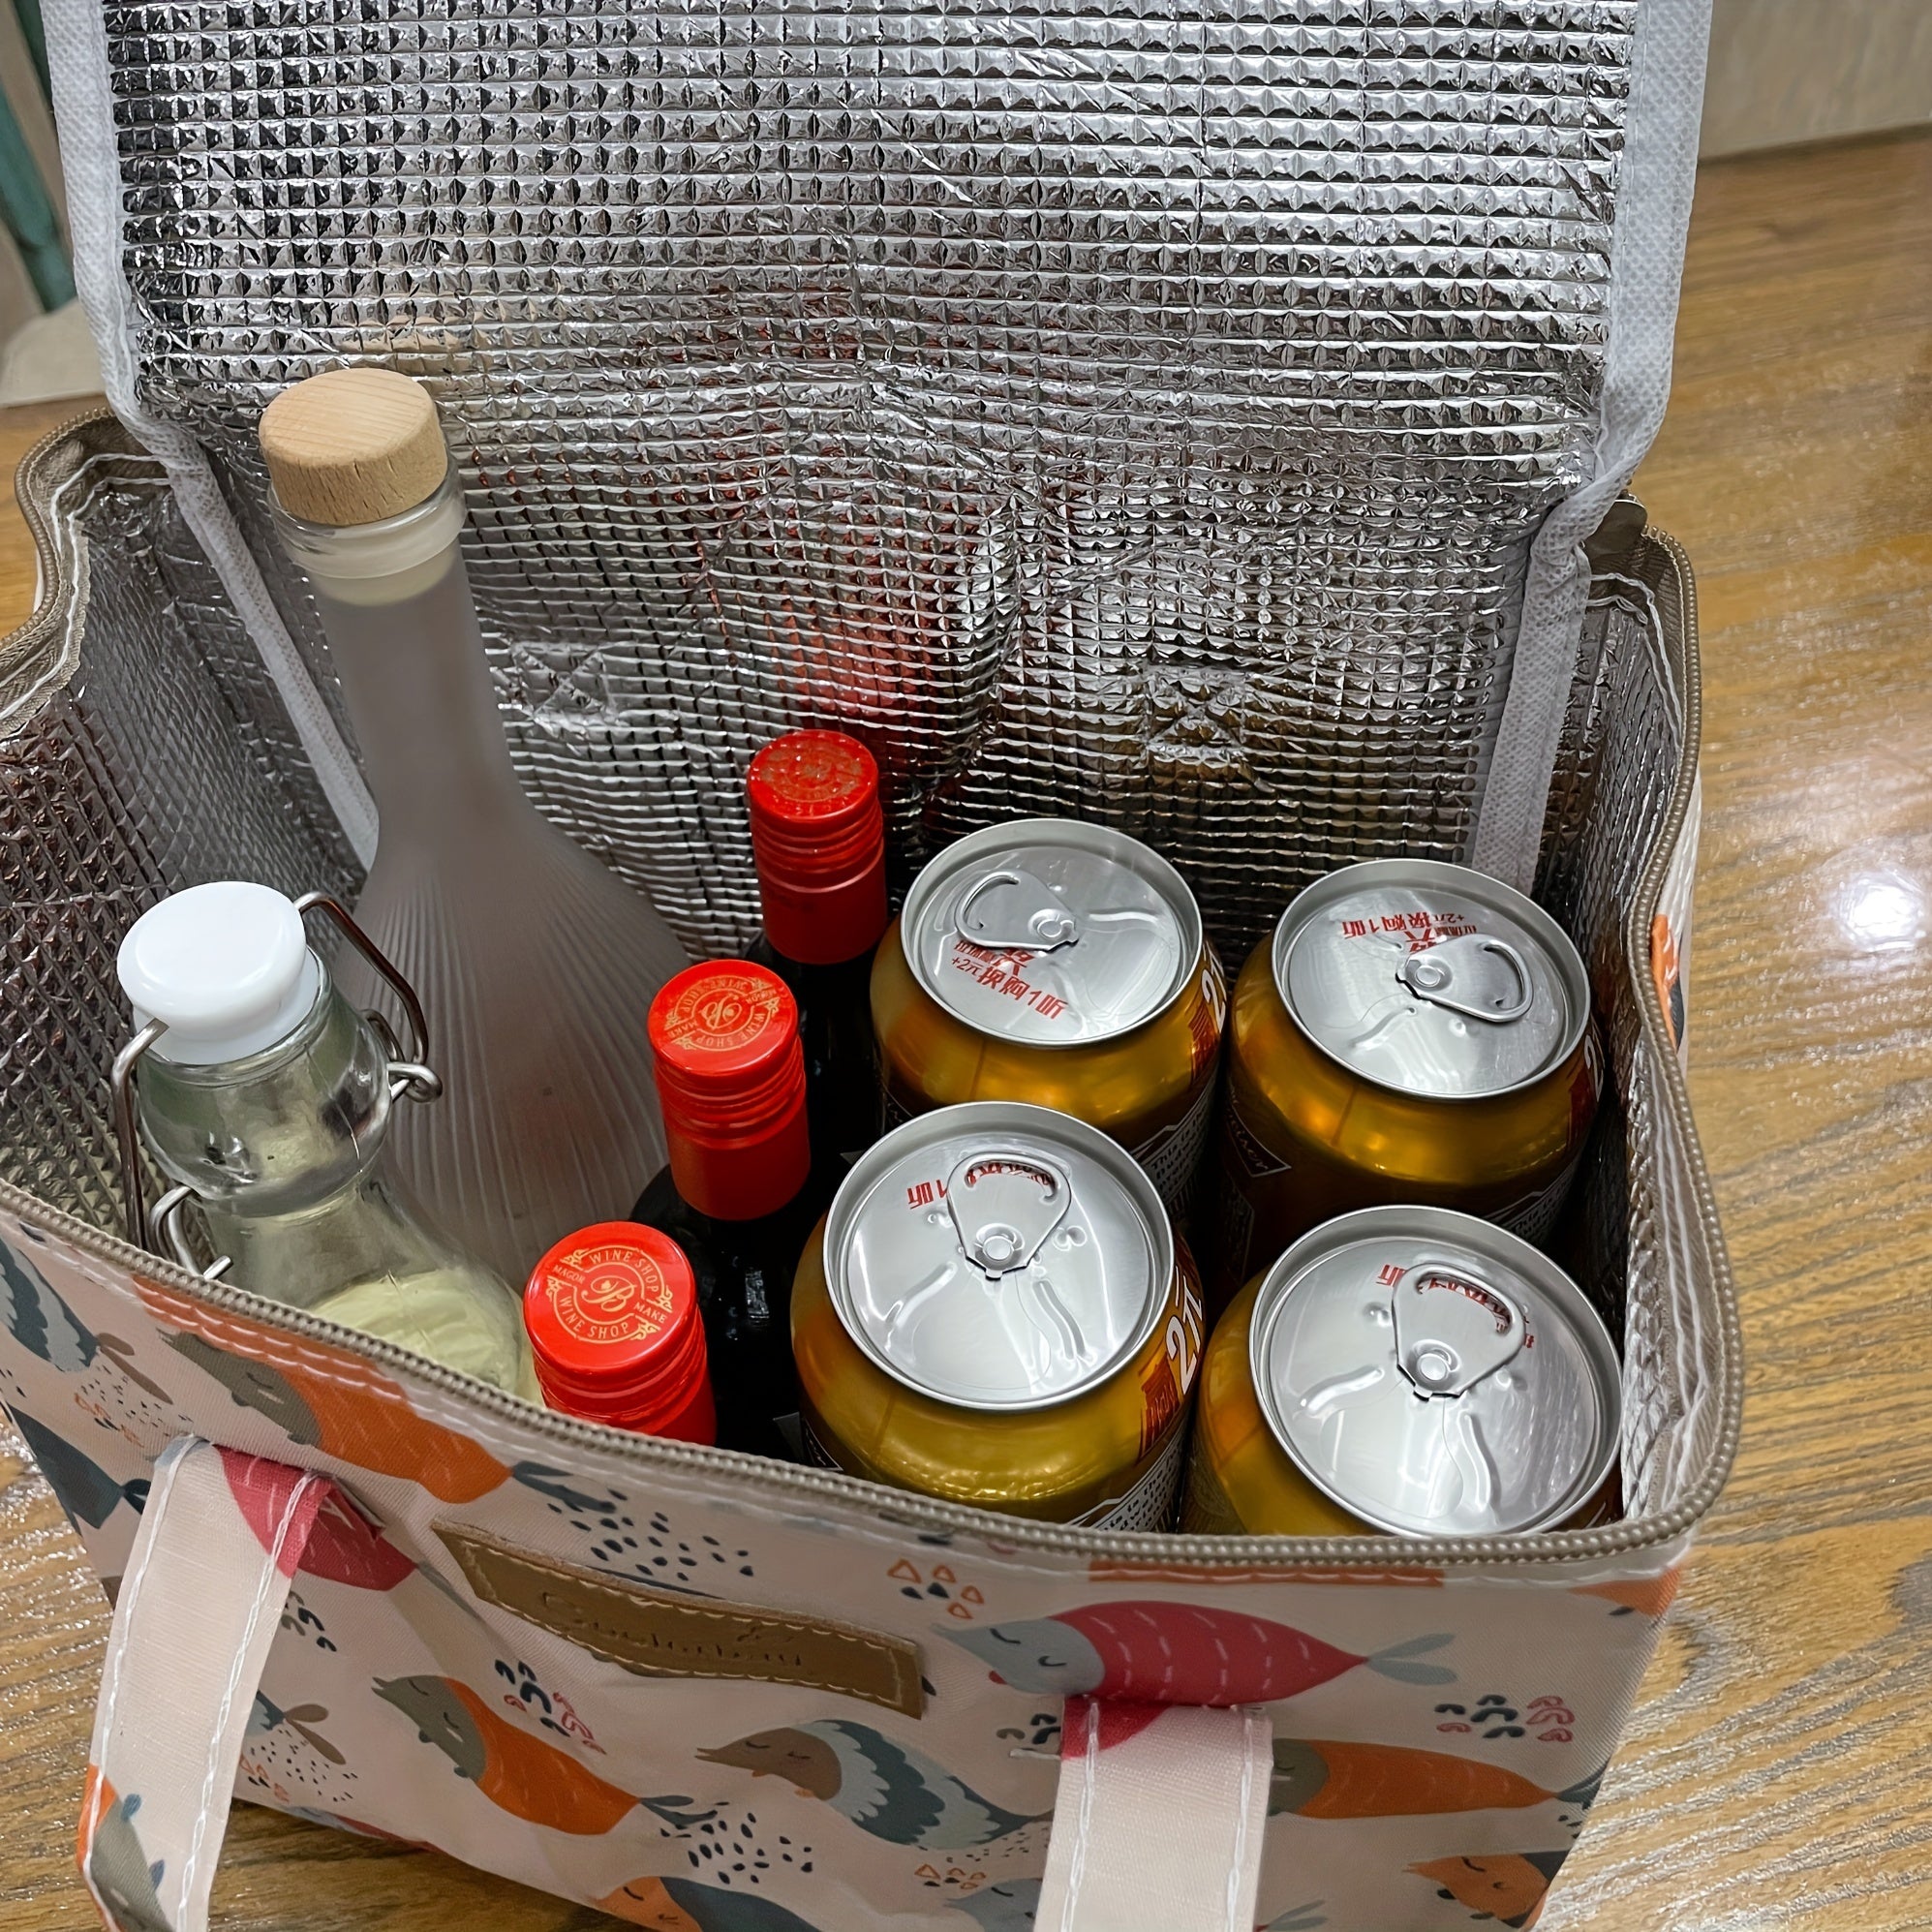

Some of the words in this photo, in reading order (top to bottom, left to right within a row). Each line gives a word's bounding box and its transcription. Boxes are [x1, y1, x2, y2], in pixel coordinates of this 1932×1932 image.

[589, 1249, 633, 1265] WINE
[634, 1258, 659, 1293] SHOP
[560, 1295, 584, 1332] WINE
[588, 1321, 629, 1339] SHOP
[633, 1303, 667, 1324] MAKE
